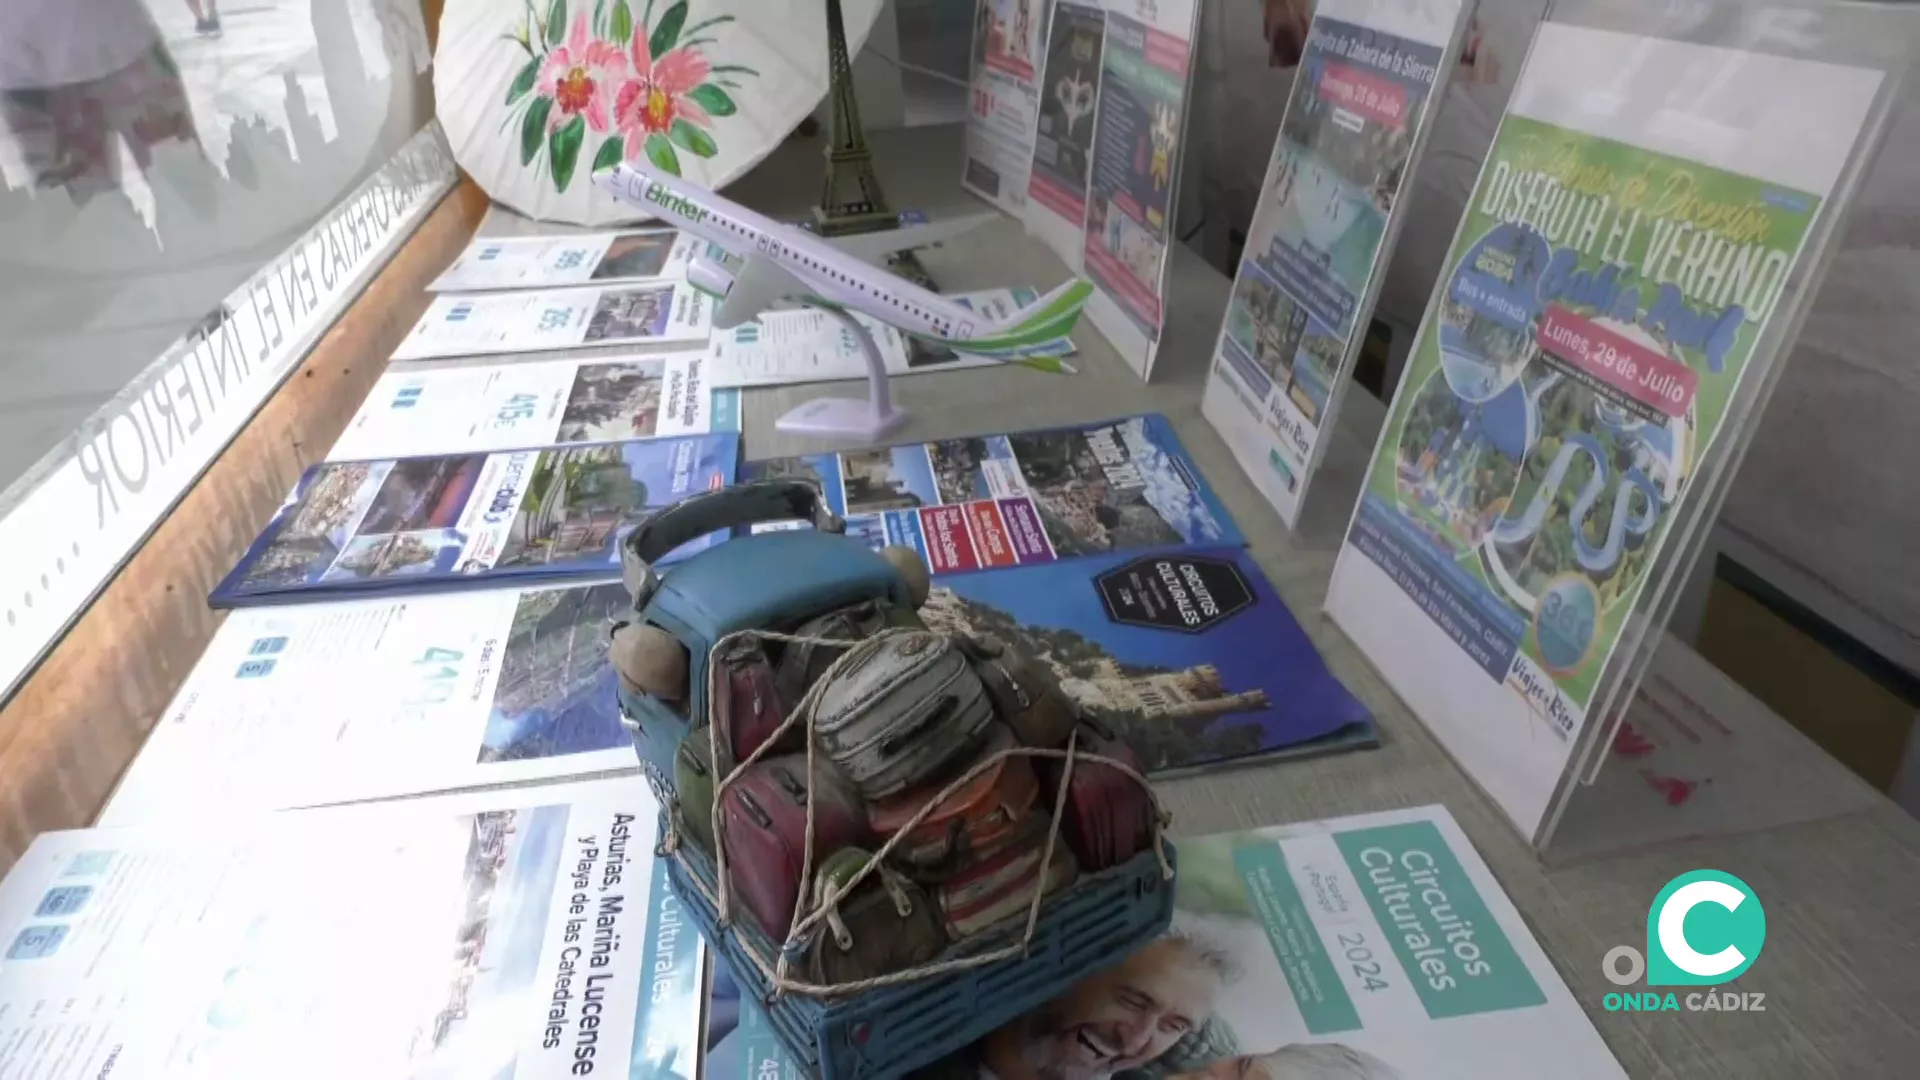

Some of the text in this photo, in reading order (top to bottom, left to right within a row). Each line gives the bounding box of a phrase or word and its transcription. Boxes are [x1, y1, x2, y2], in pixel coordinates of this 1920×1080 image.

[1402, 55, 1434, 83] Sierra
[645, 181, 710, 224] Binter
[1481, 161, 1610, 254] DISFRUTA
[1602, 205, 1641, 265] EL
[1641, 218, 1788, 323] VERANO
[1457, 275, 1479, 298] Bus
[1486, 296, 1527, 323] entrada
[1544, 317, 1590, 361] Lunes,
[1593, 342, 1614, 369] 29
[1616, 351, 1639, 380] de
[1638, 367, 1685, 403] Julio
[1156, 561, 1201, 625] CULTURALES
[1179, 563, 1219, 616] CIRCUITOS
[543, 835, 599, 1050] y Playa de las Catedrales
[572, 812, 636, 1077] Asturias, Mariña Lucense
[652, 896, 682, 1004] Culturales
[1360, 847, 1456, 991] Culturales
[1400, 849, 1492, 976] Circuitos
[1337, 933, 1389, 992] 2024
